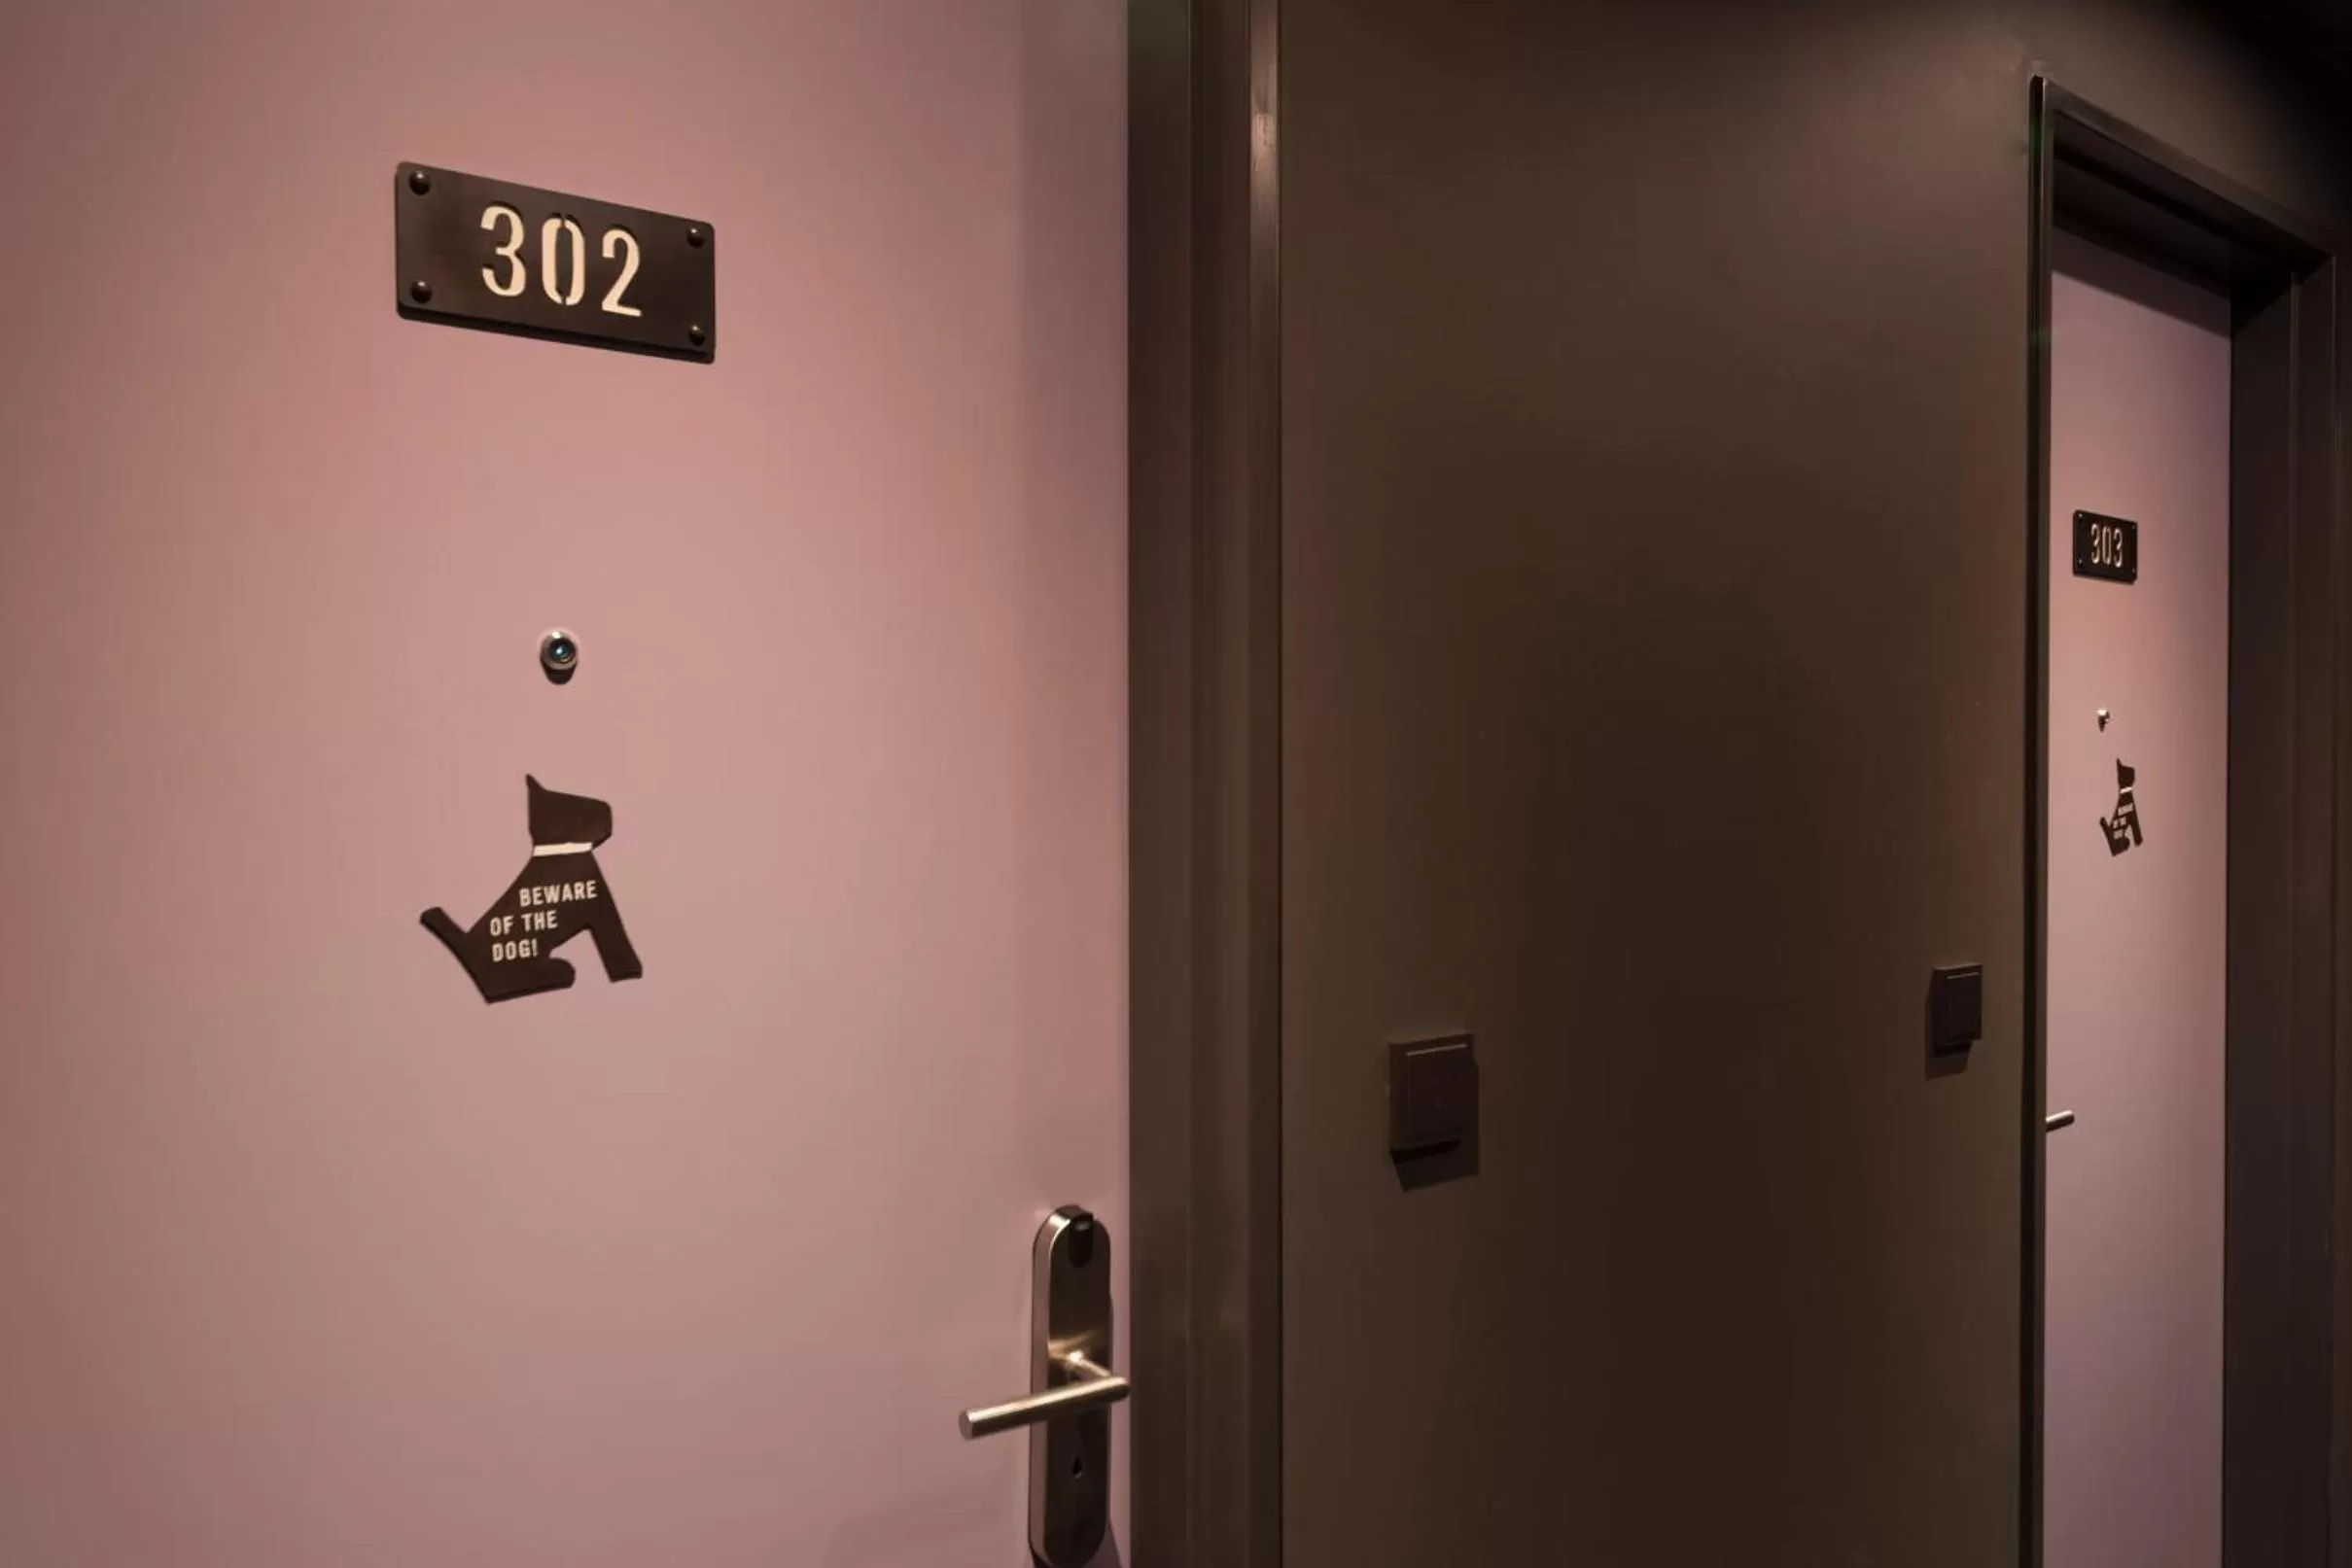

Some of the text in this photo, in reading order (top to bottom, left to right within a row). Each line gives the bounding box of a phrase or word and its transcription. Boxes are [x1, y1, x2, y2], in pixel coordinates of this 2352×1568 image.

[480, 205, 643, 318] 302
[2091, 523, 2123, 568] 303
[518, 880, 598, 907] BEWARE
[490, 910, 558, 936] OF THE
[492, 938, 539, 962] DOG!
